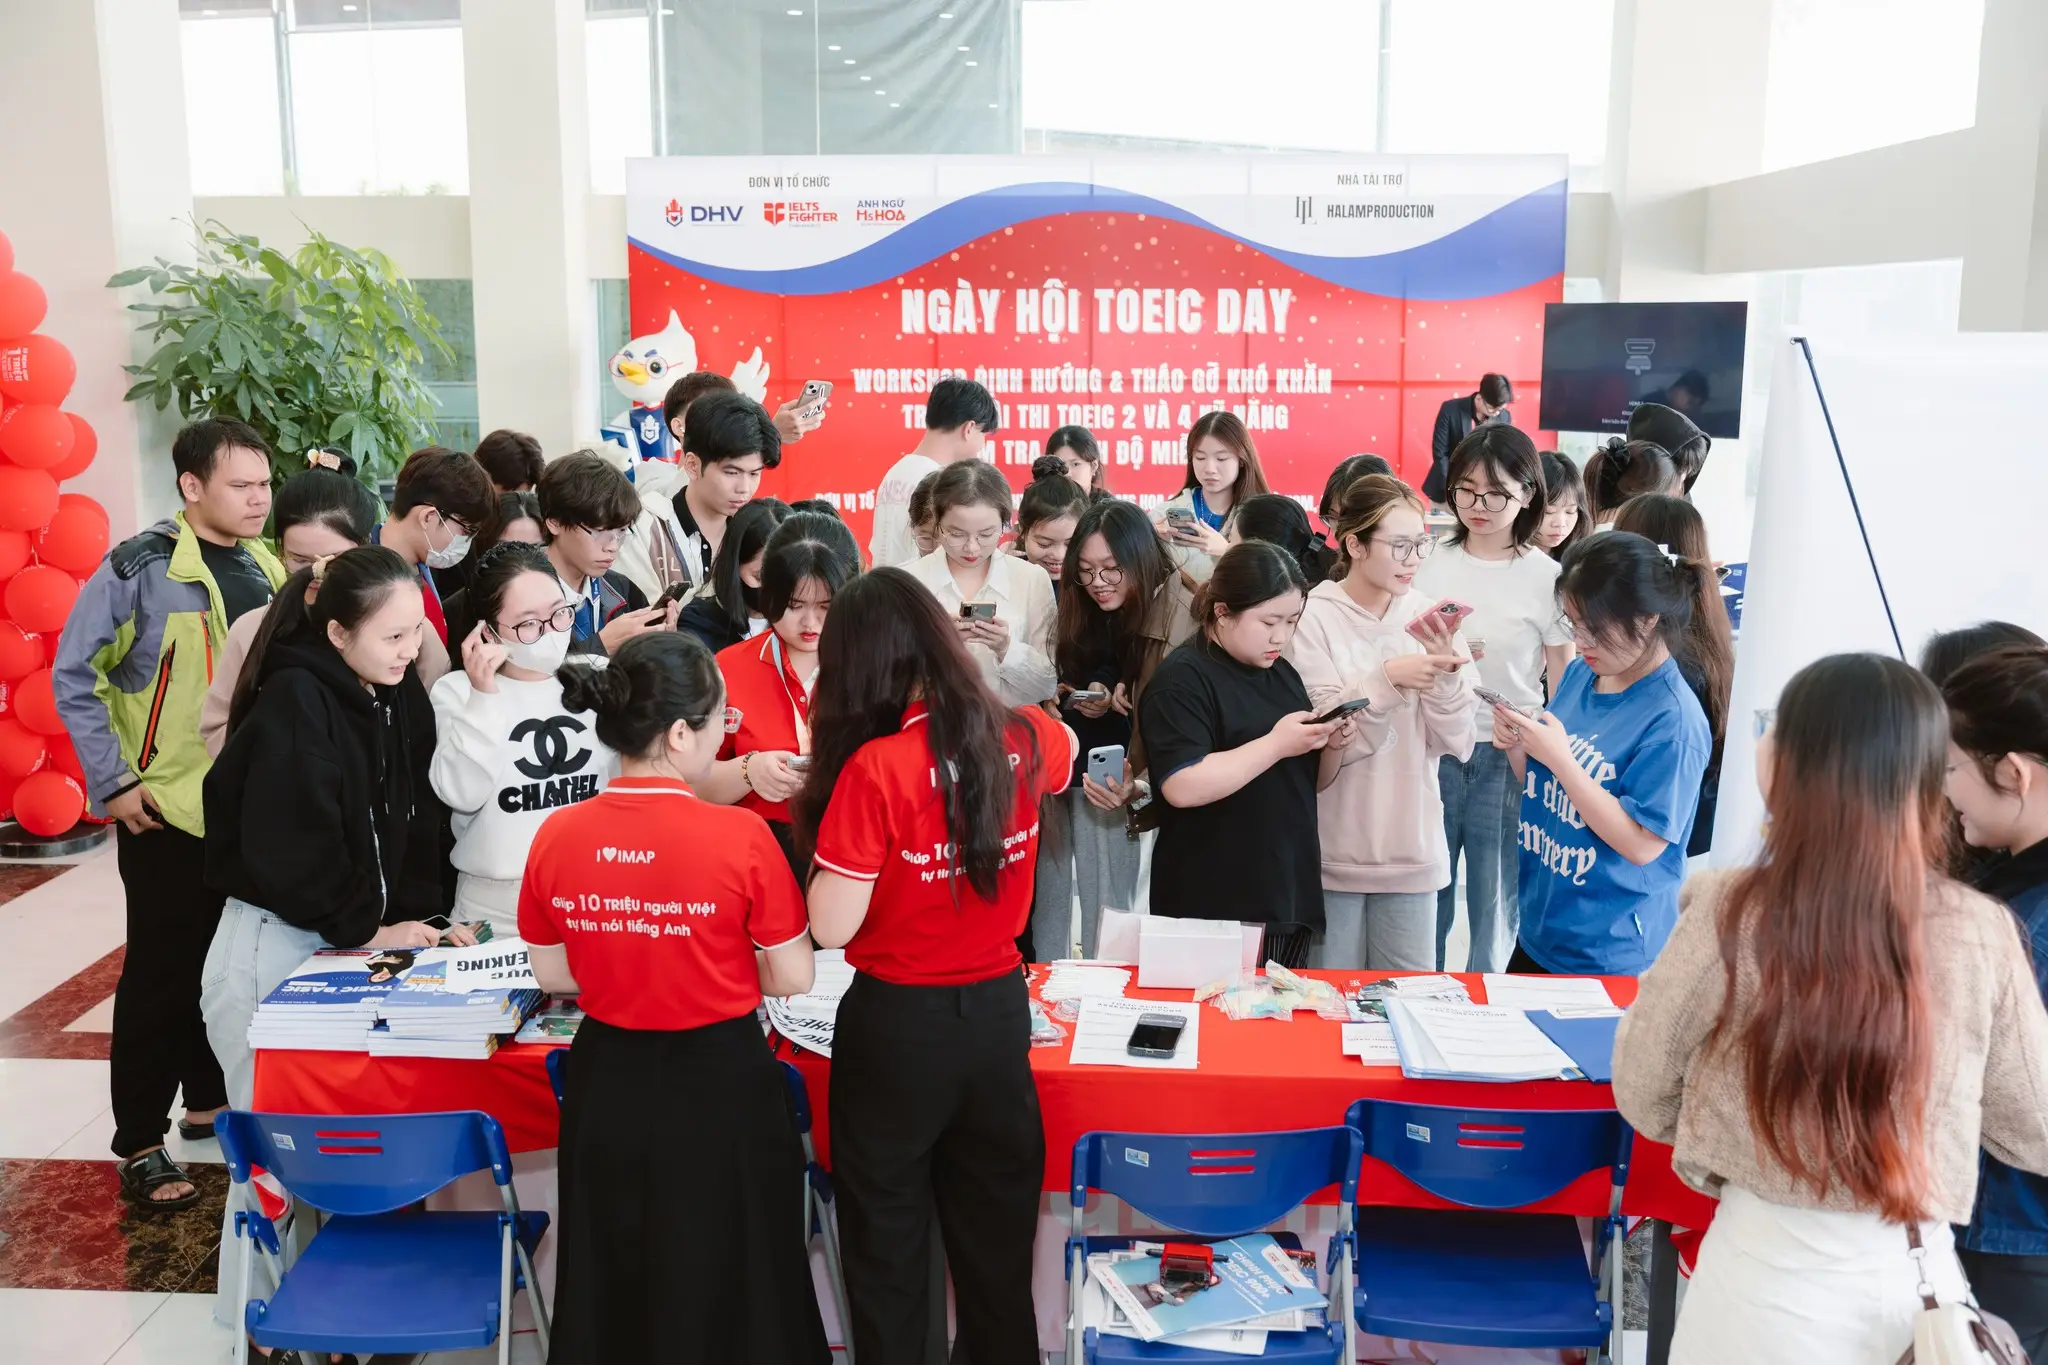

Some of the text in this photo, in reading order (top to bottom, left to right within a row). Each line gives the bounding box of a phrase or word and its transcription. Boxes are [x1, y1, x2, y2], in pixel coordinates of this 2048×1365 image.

[749, 176, 770, 188] ĐƠN
[773, 176, 783, 191] VỊ
[802, 174, 830, 188] CHỨC
[691, 206, 744, 222] DHV
[788, 202, 819, 212] IELTS
[857, 200, 879, 208] ANH
[1327, 204, 1434, 218] HALAMPRODUCTION
[901, 277, 1292, 343] NGÀY HỘI TOEIC DAY
[1030, 362, 1102, 393] HƯỚNG
[1109, 370, 1124, 393] &
[1131, 362, 1185, 393] THÁO
[1192, 361, 1220, 393] GỠ
[1227, 363, 1268, 393] KHÓ
[1017, 404, 1049, 429] THI
[1057, 404, 1114, 429] TOEIC
[1122, 404, 1136, 429] 2
[1143, 399, 1170, 429] VÀ
[1177, 404, 1191, 429] 4
[1003, 440, 1040, 465] TRA
[1116, 435, 1144, 470] ĐỘ
[1151, 433, 1189, 465] MIỄ
[843, 493, 856, 513] VỊ
[617, 850, 656, 864] IMAP
[901, 850, 930, 865] Giúp
[934, 843, 957, 861] 10
[1003, 831, 1027, 849] gười
[921, 871, 934, 883] tự
[1008, 850, 1025, 863] Anh
[578, 894, 600, 912] 10
[603, 896, 640, 914] TRIỆU
[643, 900, 682, 916] người
[686, 901, 716, 917] Việt
[566, 917, 691, 937] tự tin nói tiếng Anh
[457, 951, 528, 972] EAKING
[281, 984, 342, 993] BASIC
